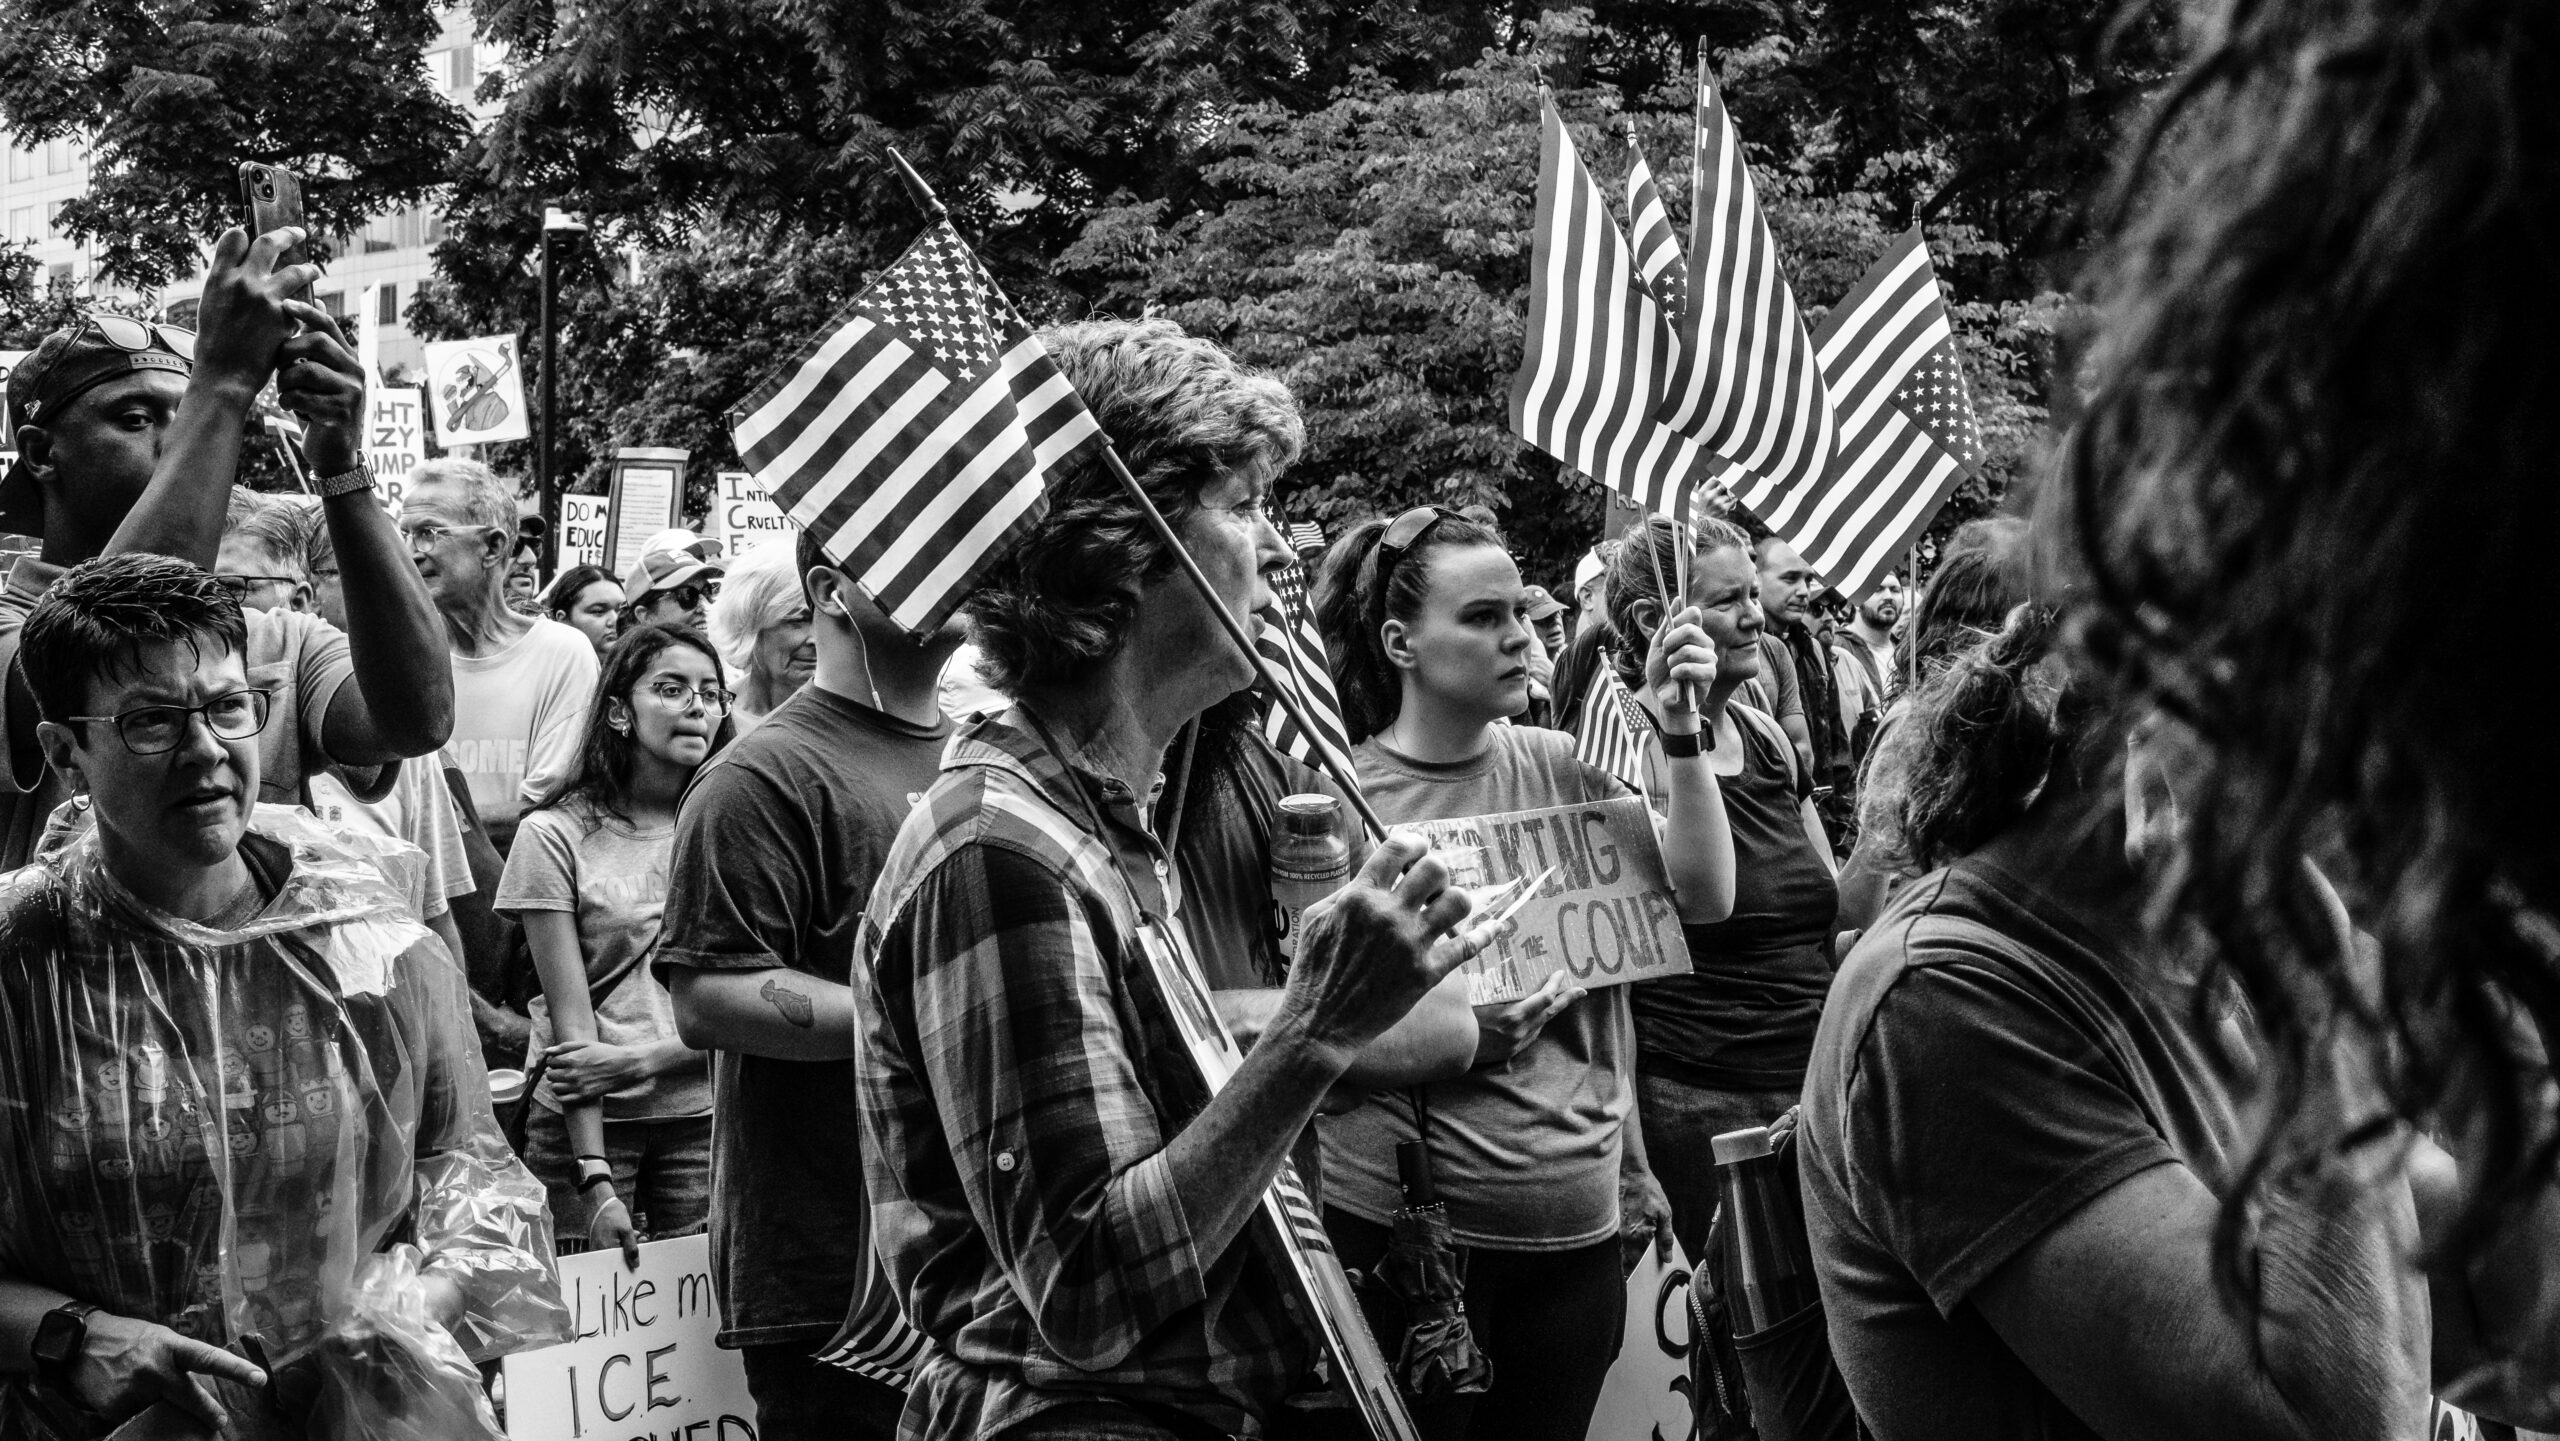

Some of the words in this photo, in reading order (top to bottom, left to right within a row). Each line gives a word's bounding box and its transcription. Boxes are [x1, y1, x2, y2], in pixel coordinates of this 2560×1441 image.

[374, 400, 414, 424] HT
[373, 426, 414, 448] ZY
[567, 501, 590, 522] DO
[595, 504, 607, 519] M
[566, 526, 603, 548] EDUC
[1303, 872, 1330, 881] RECYCLED
[1520, 934, 1548, 960] THE
[1557, 890, 1669, 980] COUP
[574, 1271, 658, 1343] Like
[678, 1272, 711, 1321] m
